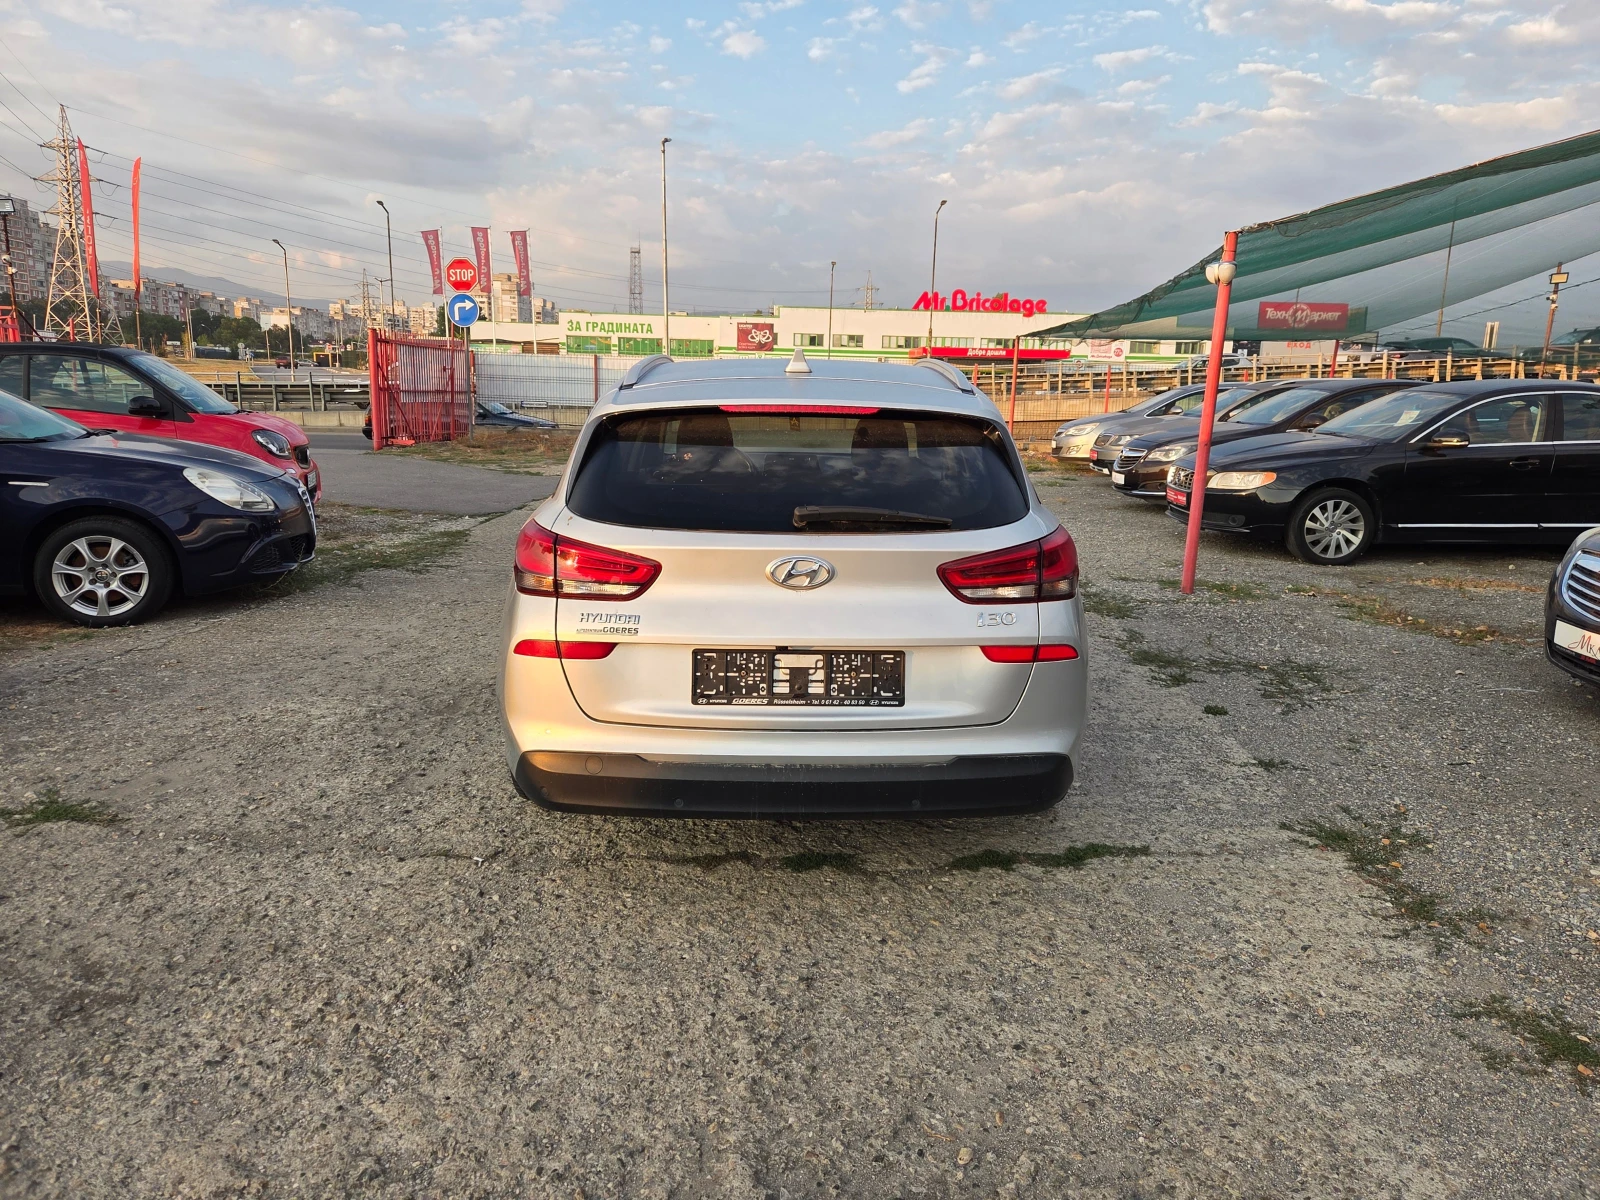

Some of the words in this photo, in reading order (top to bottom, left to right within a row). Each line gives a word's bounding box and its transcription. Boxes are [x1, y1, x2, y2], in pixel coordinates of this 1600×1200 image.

[449, 269, 474, 281] STOP
[912, 291, 946, 311] Mr
[951, 289, 1047, 317] Bricolage
[567, 320, 582, 332] ЗА
[585, 321, 653, 334] ГРАДИНАТА
[967, 348, 986, 356] Добре
[579, 612, 641, 625] HYUNDAI
[602, 626, 639, 634] GOERES
